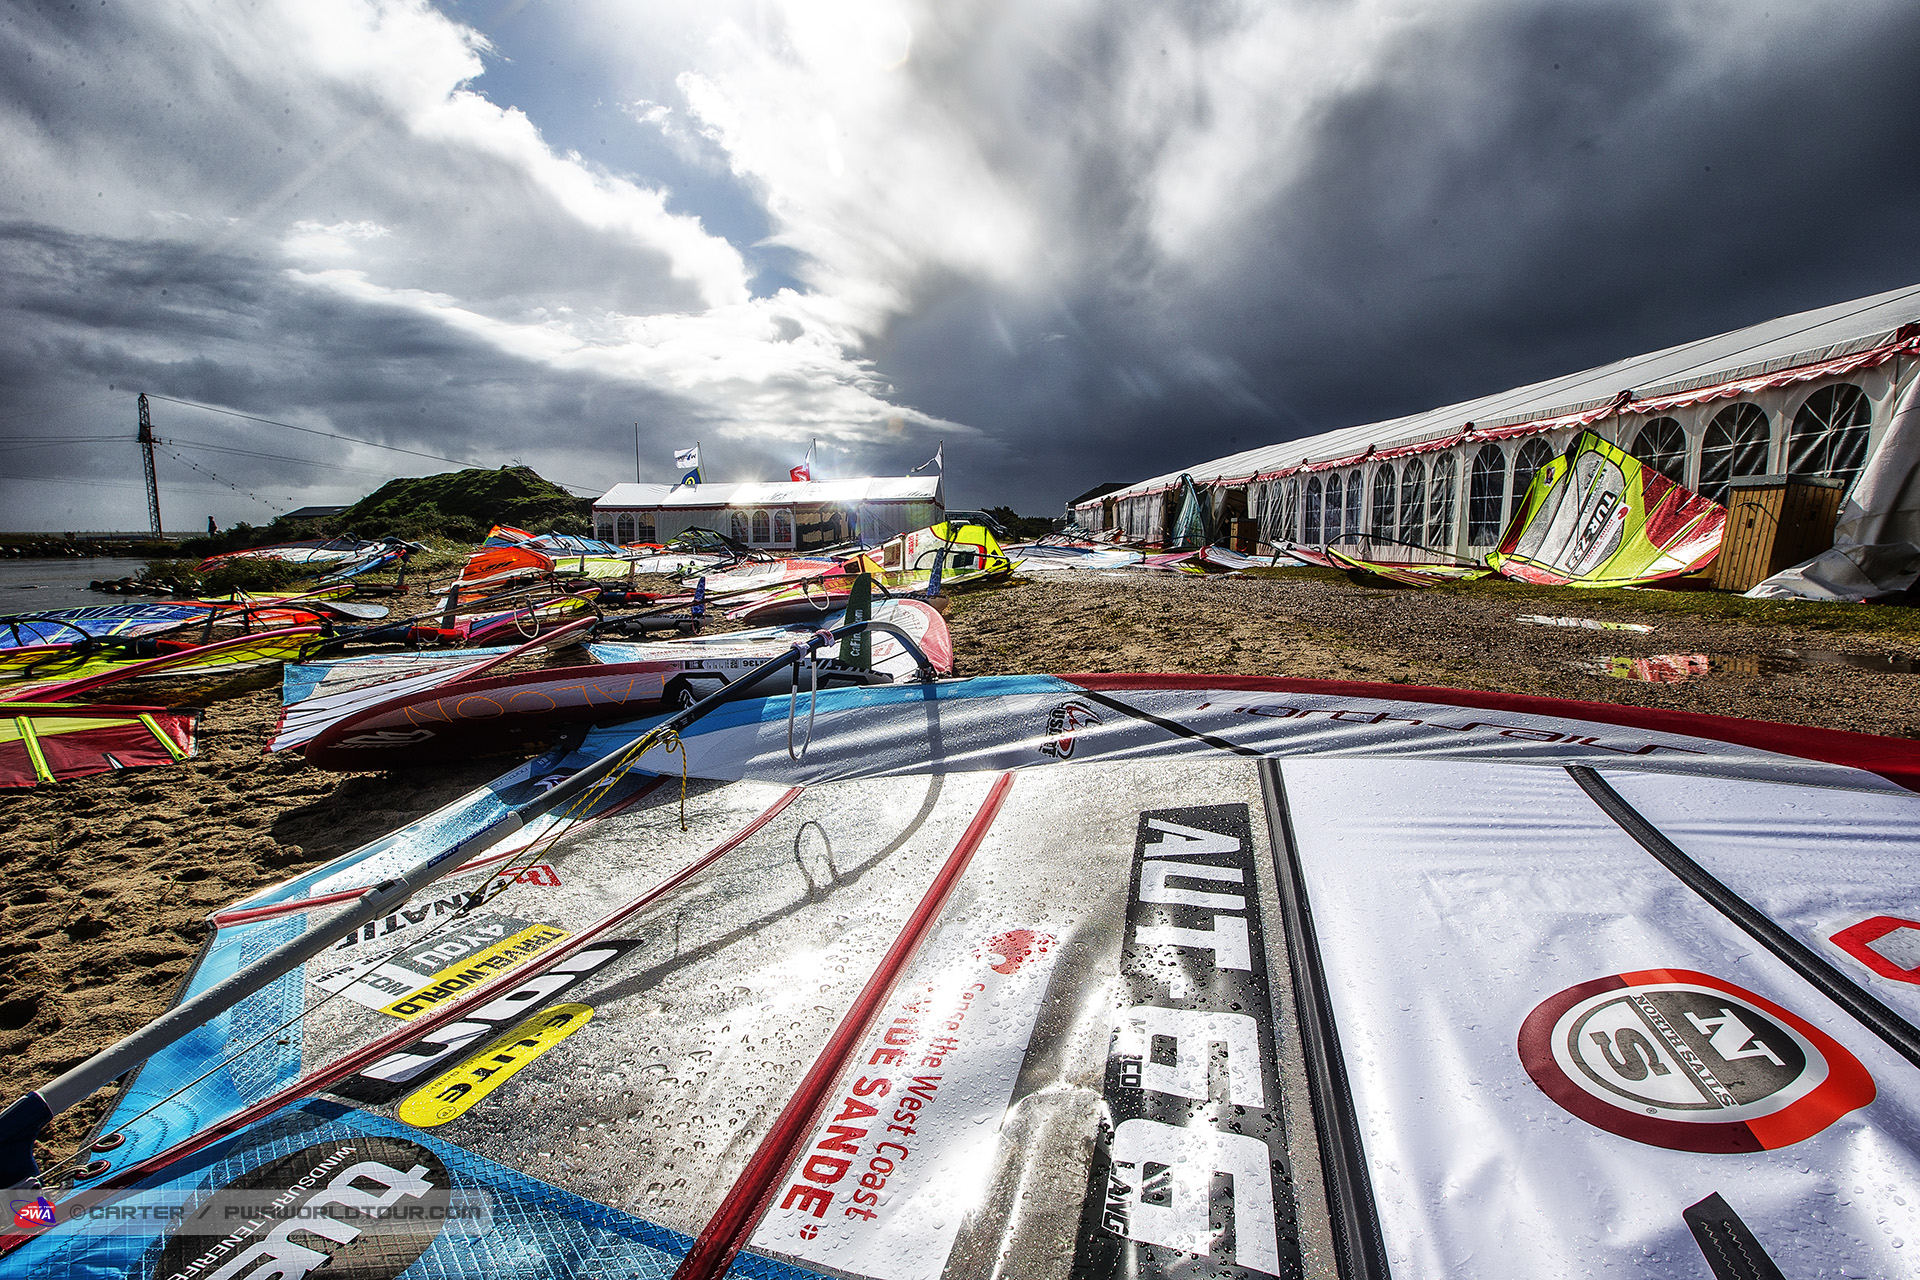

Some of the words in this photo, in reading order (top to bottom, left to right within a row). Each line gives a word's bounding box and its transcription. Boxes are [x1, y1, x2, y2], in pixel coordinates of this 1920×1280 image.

[404, 674, 664, 727] FALCON
[391, 930, 564, 1016] TRAVELWORLD
[412, 923, 504, 971] 4YOU
[920, 1034, 958, 1068] the
[1113, 817, 1281, 1278] AUT-66
[1632, 994, 1683, 1052] NORTH
[1680, 1051, 1738, 1108] SAILS
[779, 1075, 893, 1220] SANDE
[887, 1075, 943, 1137] West
[844, 1139, 909, 1222] Coast
